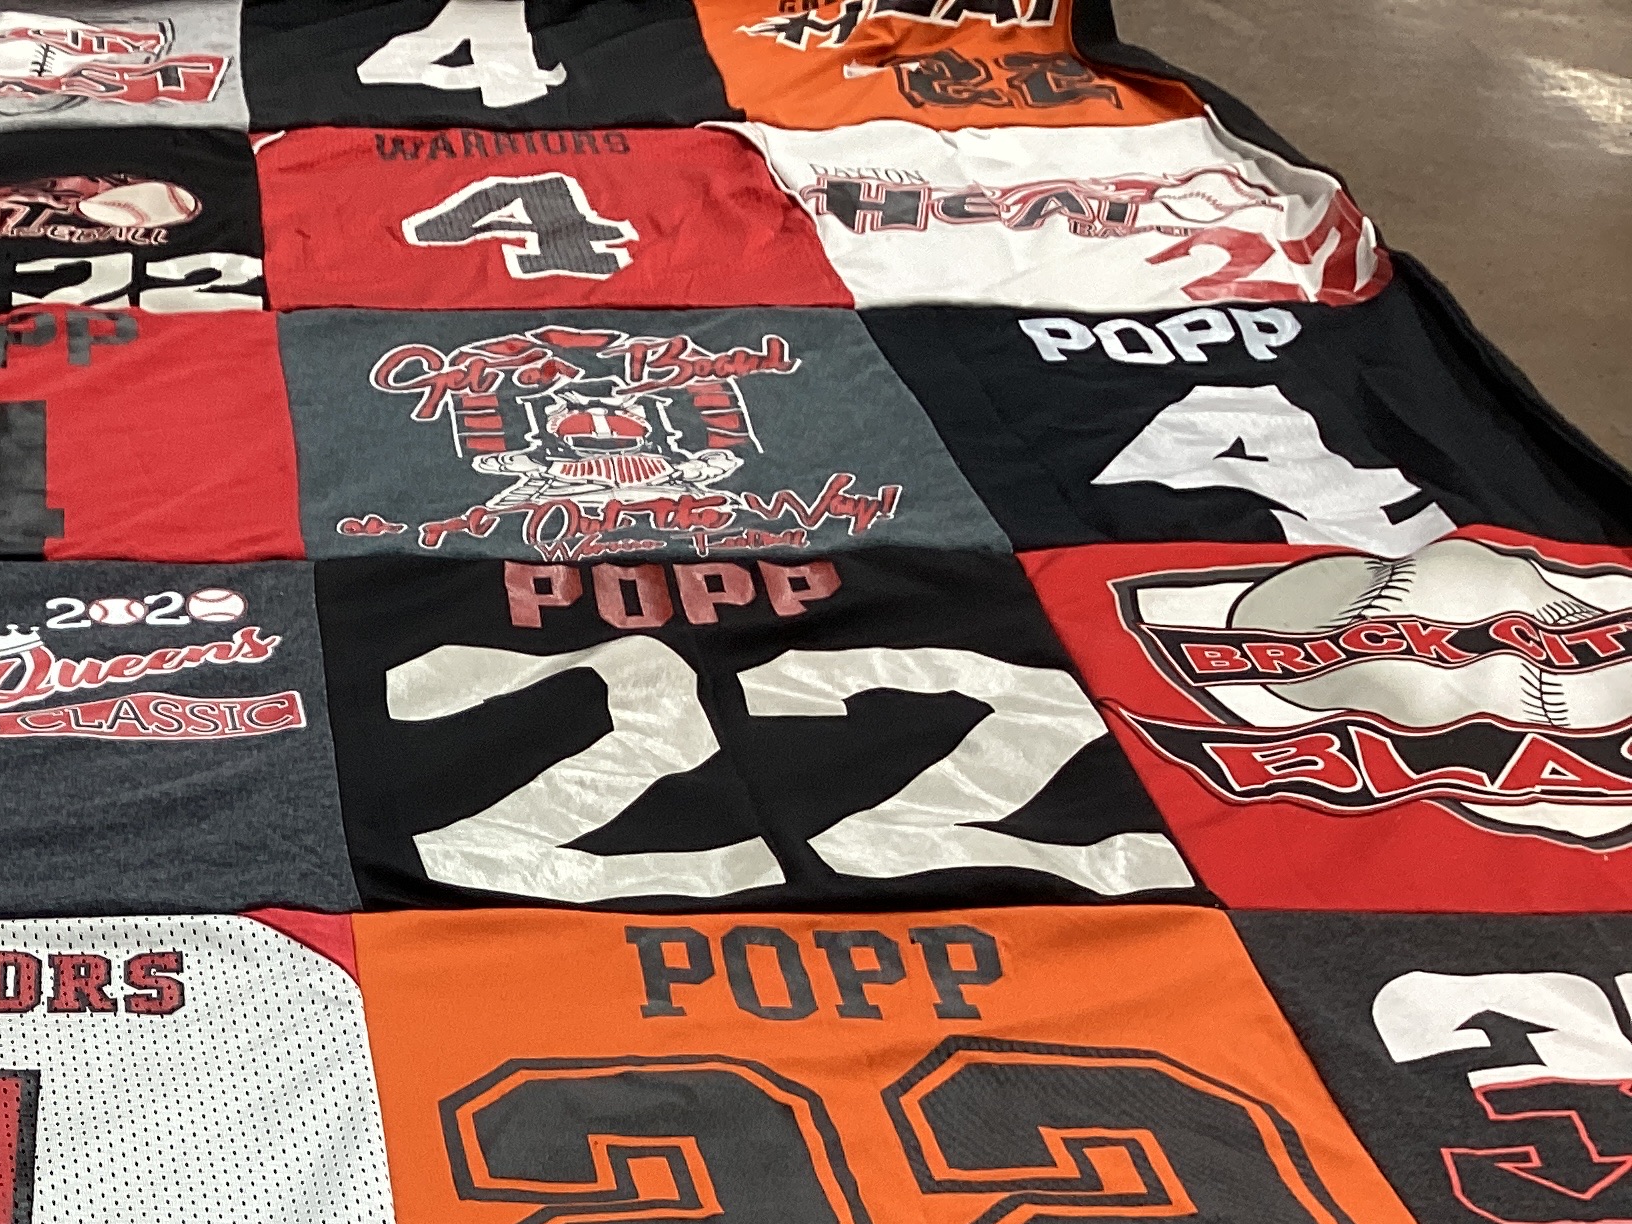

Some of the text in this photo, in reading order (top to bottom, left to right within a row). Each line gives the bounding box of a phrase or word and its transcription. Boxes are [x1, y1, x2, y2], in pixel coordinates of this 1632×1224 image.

[356, 0, 568, 108] 4
[373, 129, 632, 162] WARRIORS
[808, 163, 927, 187] DAYTON
[401, 171, 641, 281] 4
[10, 251, 264, 314] 22
[1016, 306, 1303, 365] POPP
[369, 343, 555, 422] Get
[596, 333, 803, 396] Board
[742, 473, 903, 536] Way!
[1089, 383, 1459, 559] 4
[501, 560, 843, 630] POPP
[1180, 615, 1632, 676] BRICK CIT
[18, 694, 294, 740] CLASSIC
[385, 634, 1197, 904] 22
[1200, 723, 1632, 800] BLA
[624, 924, 1006, 1022] POPP
